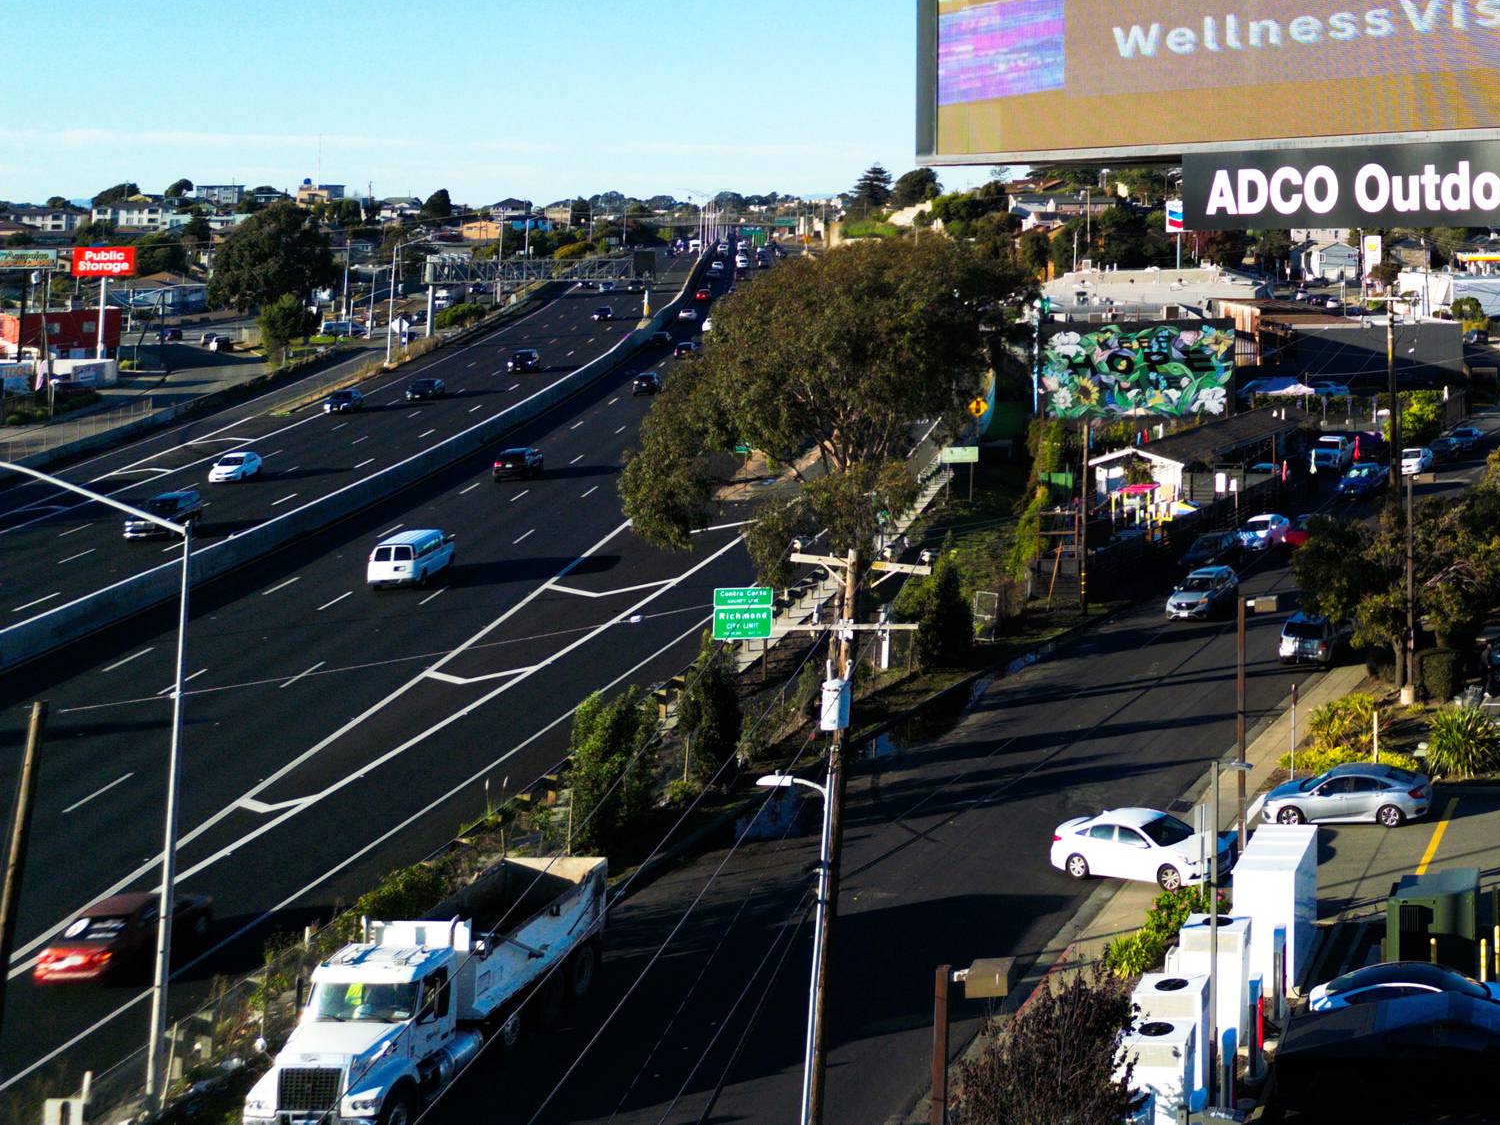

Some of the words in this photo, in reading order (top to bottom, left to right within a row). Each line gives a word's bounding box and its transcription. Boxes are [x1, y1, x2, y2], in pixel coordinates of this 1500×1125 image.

[1205, 165, 1339, 216] ADCO
[84, 250, 126, 261] Public
[78, 261, 129, 273] Storage
[719, 612, 767, 620] Richmond
